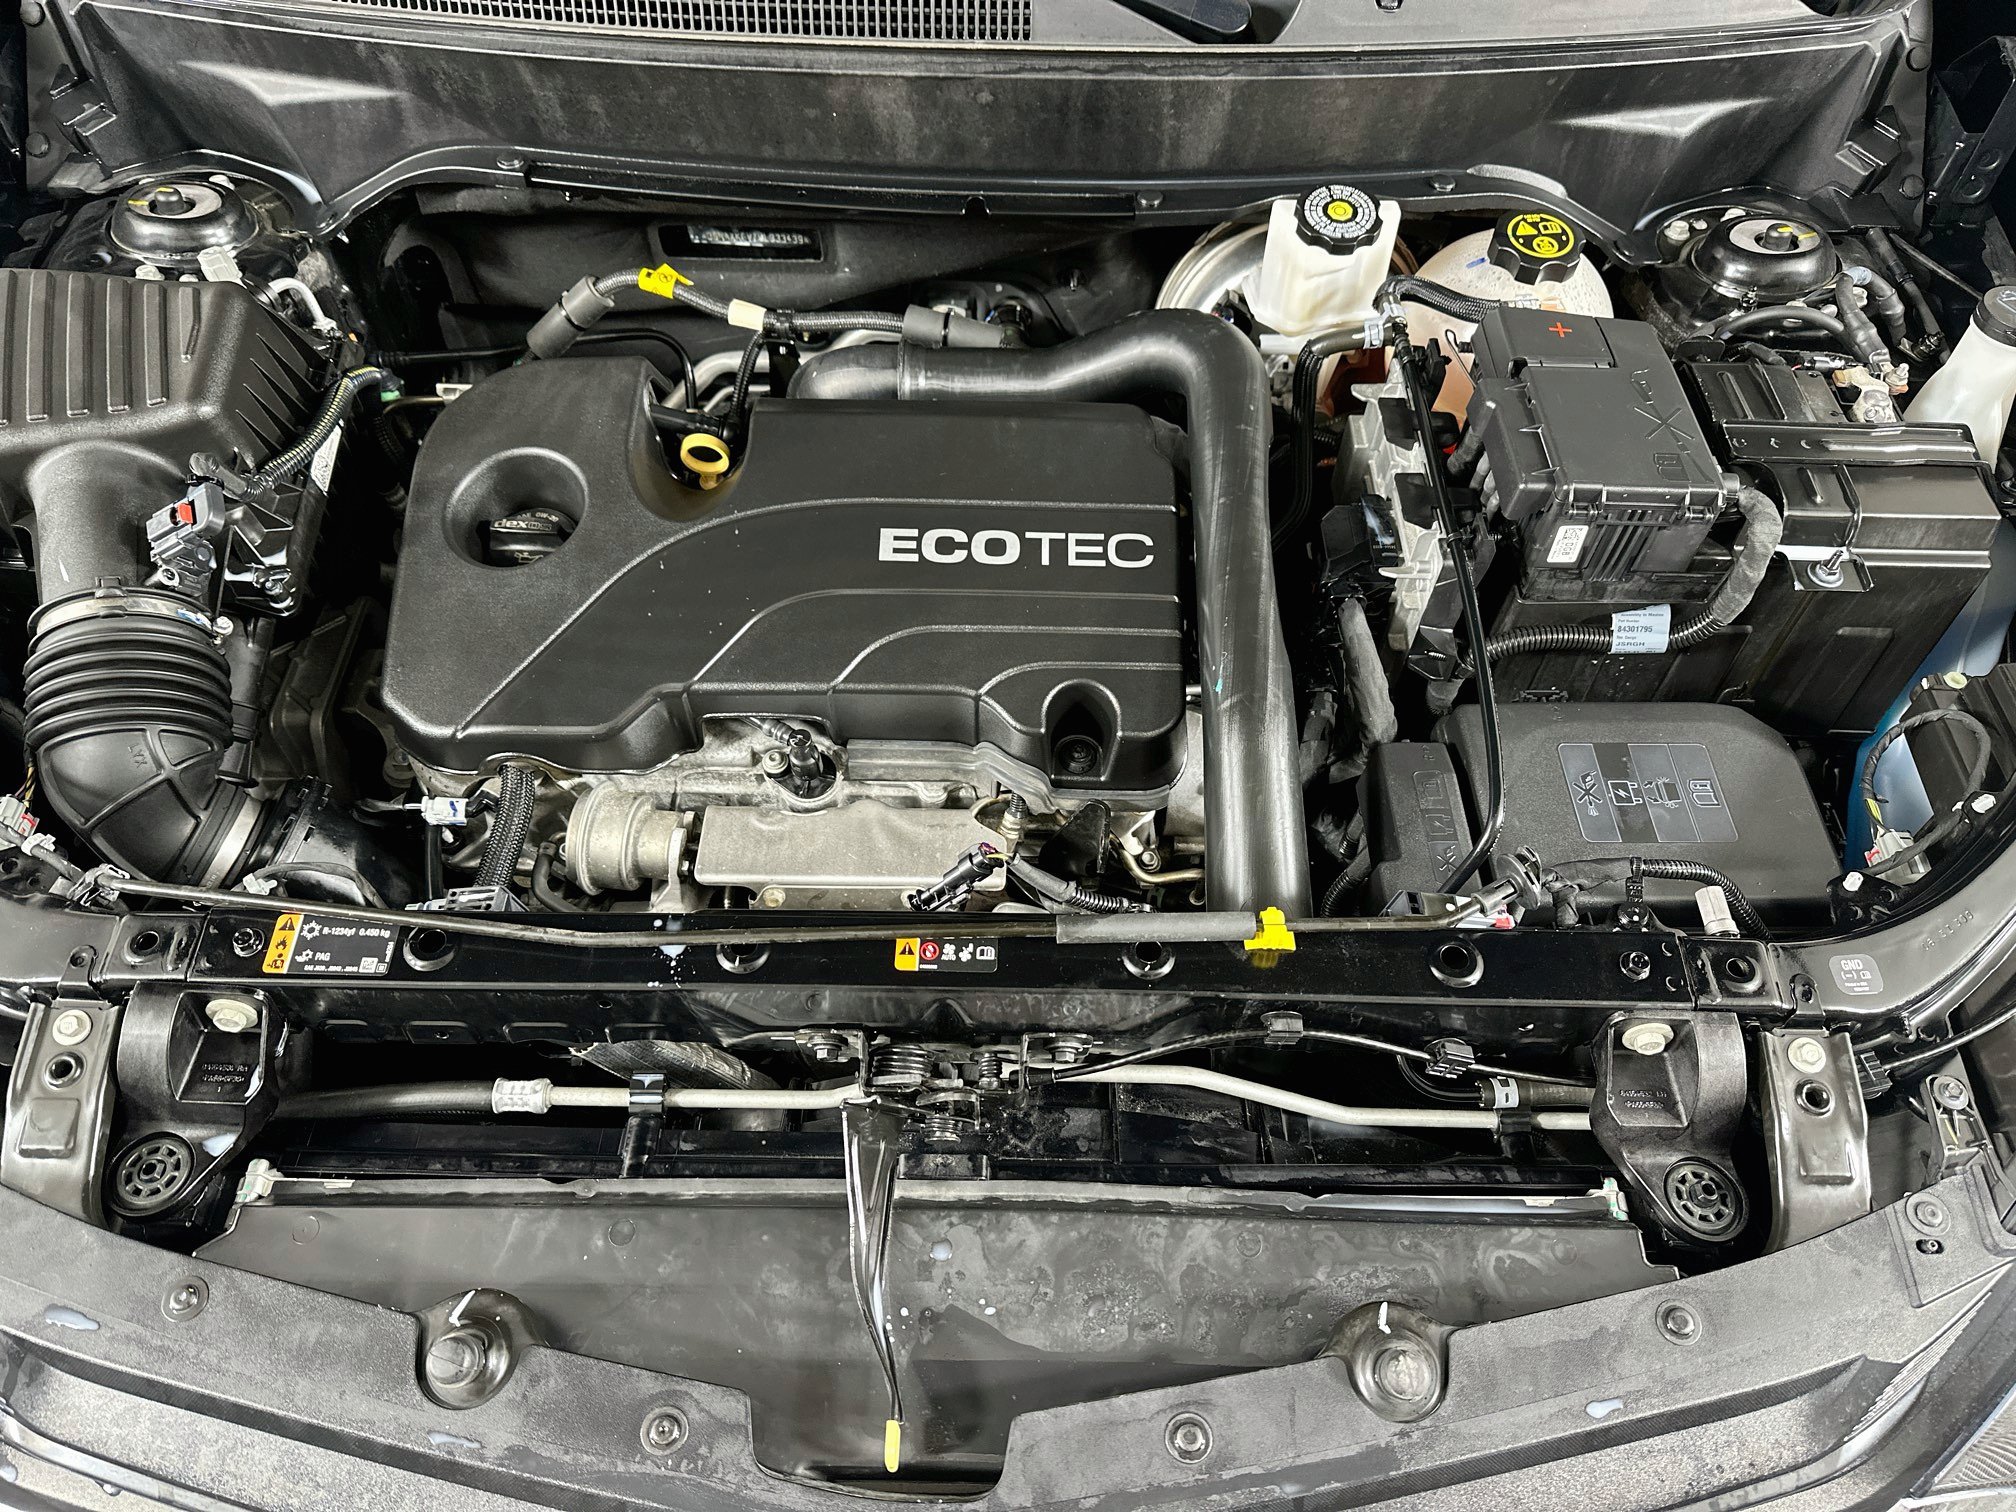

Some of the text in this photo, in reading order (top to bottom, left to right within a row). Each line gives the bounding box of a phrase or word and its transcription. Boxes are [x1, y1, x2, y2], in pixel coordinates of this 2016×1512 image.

[494, 519, 552, 531] dexos
[878, 527, 1154, 568] ECOTEC
[1617, 625, 1653, 633] 84301795
[359, 927, 380, 936] 0.450
[380, 928, 391, 938] kg
[314, 952, 331, 962] PAG
[1840, 959, 1863, 970] GND
